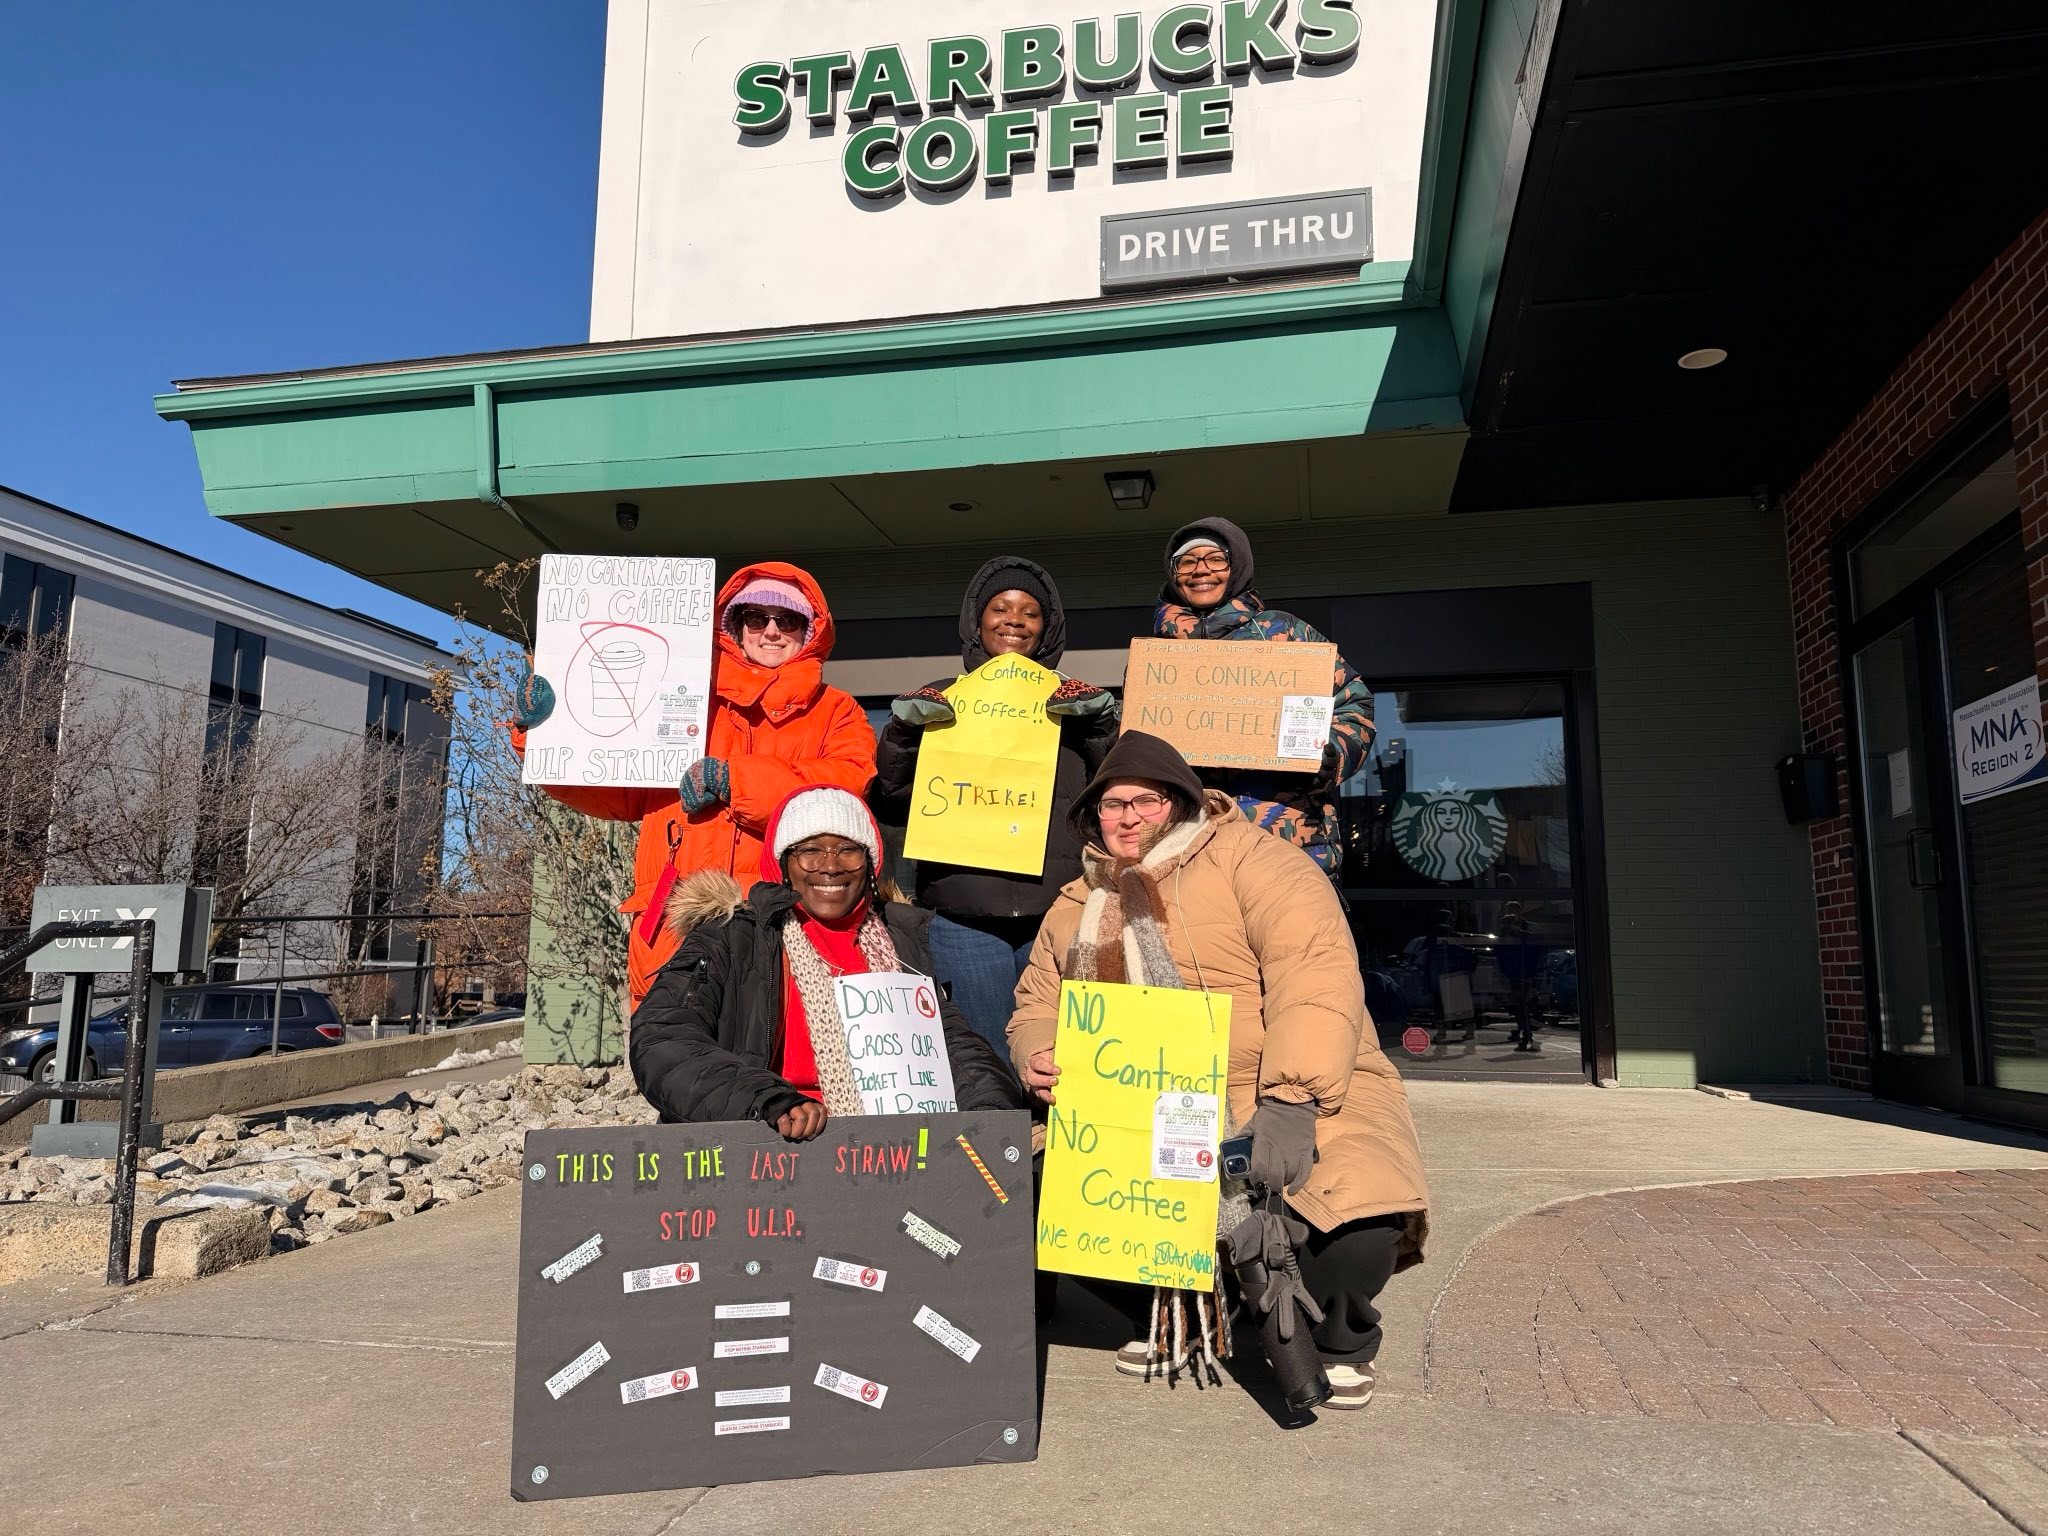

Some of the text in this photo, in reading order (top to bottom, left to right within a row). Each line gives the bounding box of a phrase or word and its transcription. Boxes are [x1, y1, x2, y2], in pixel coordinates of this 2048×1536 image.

[732, 0, 1362, 130] STARBUCKS
[841, 84, 1234, 196] COFFEE
[1119, 212, 1354, 262] DRIVE THRU
[543, 555, 714, 588] NO CONTRACT?
[546, 588, 712, 627] NO COFFEE!
[981, 660, 1045, 685] Contract
[1145, 662, 1302, 689] NO CONTRACT
[1141, 705, 1174, 728] NO
[1960, 683, 2036, 722] Massachusetts Nurses Association
[1970, 708, 2028, 754] MNA
[526, 747, 573, 781] ULP
[1971, 743, 2034, 778] REGION 2
[921, 775, 1036, 817] STRIKE!
[58, 908, 101, 922] EXIT
[55, 937, 105, 949] ONLY
[842, 984, 914, 1019] DON'T
[847, 1023, 939, 1060] CROSS OUR
[852, 1064, 938, 1091] PICKET LINE
[556, 1153, 614, 1182] THIS
[638, 1153, 660, 1181] IS
[683, 1147, 725, 1180] THE
[750, 1150, 800, 1181] LAST
[1081, 1168, 1188, 1223] Coffee
[660, 1207, 802, 1241] STOP U.L.P.
[904, 1212, 918, 1226] NO
[906, 1226, 920, 1239] NO
[1040, 1219, 1068, 1250] We
[1077, 1231, 1112, 1256] are
[1122, 1237, 1147, 1260] on
[542, 1265, 556, 1279] NO
[553, 1269, 569, 1283] NO
[1138, 1265, 1196, 1289] Strike
[922, 1321, 935, 1333] NO
[933, 1328, 952, 1343] HAY
[926, 1311, 975, 1349] SIN CONTRATO
[549, 1344, 602, 1389] SIN CONTRATO
[556, 1383, 571, 1396] NO
[569, 1367, 586, 1387] HAY
